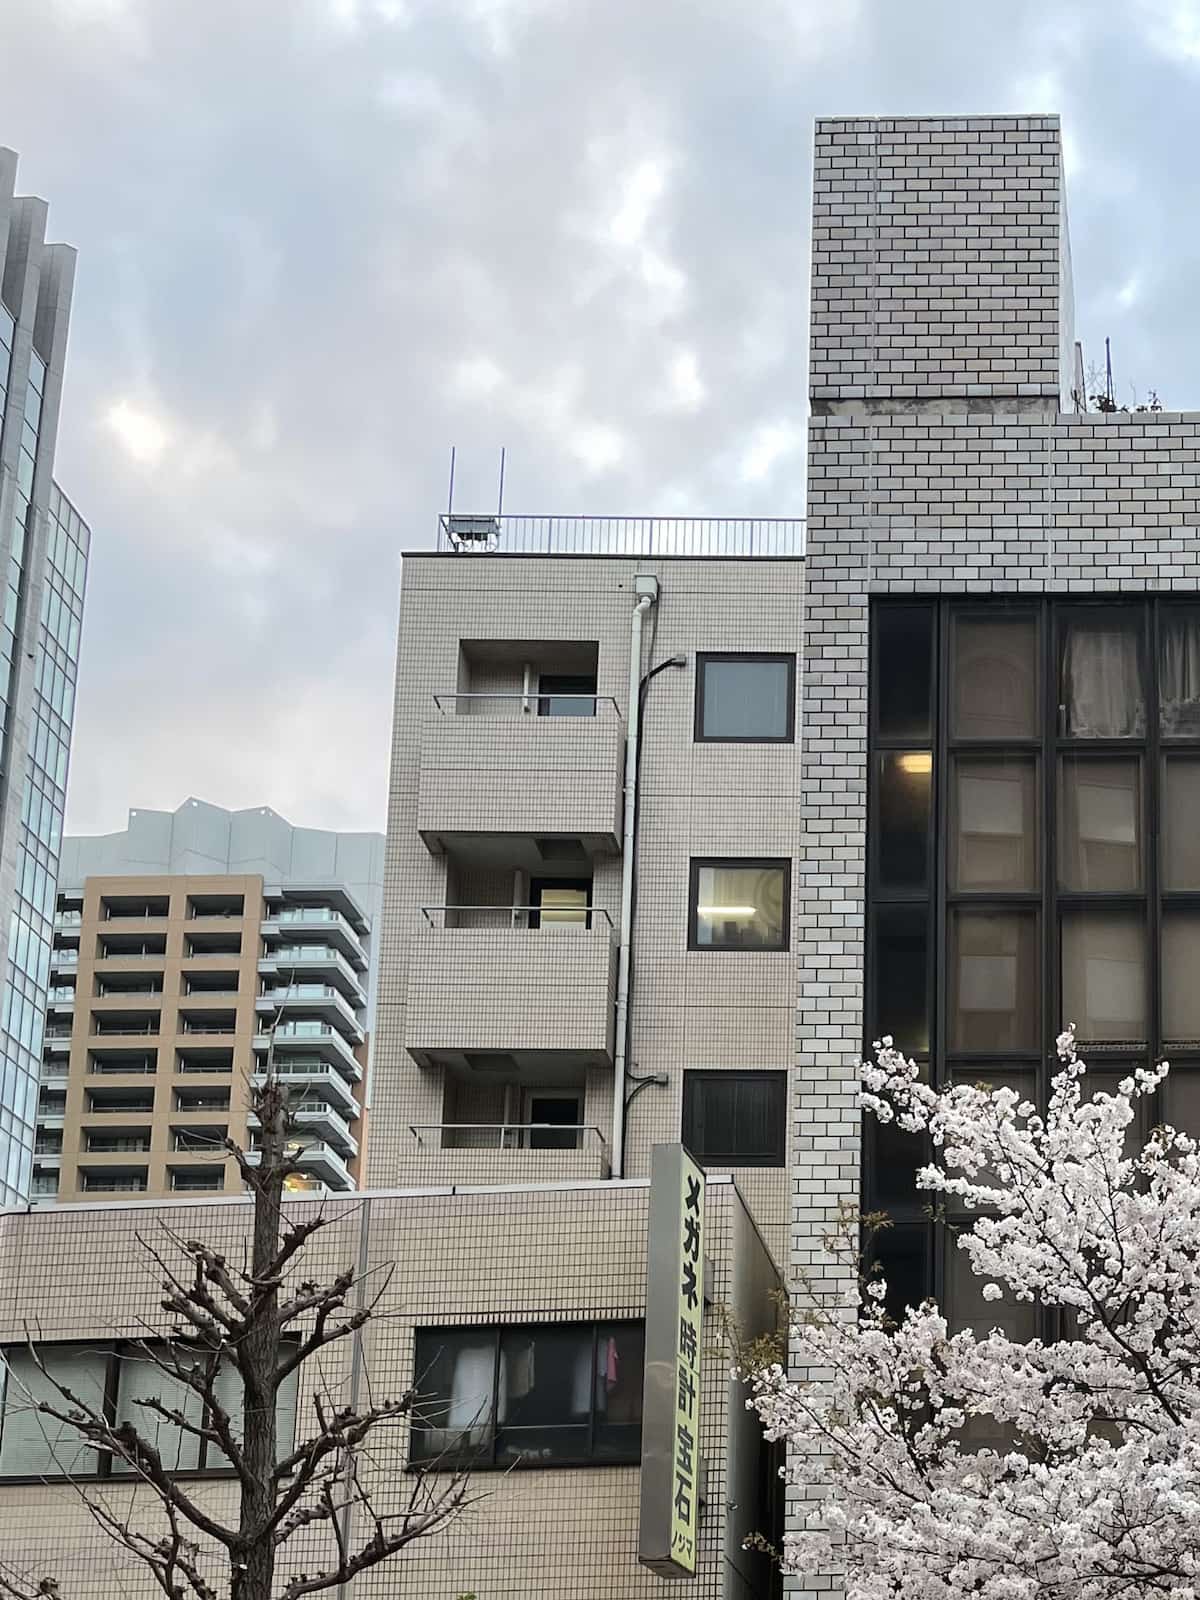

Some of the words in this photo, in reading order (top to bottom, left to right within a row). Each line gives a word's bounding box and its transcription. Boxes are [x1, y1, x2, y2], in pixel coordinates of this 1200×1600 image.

[682, 1175, 701, 1310] メガネ
[679, 1315, 697, 1419] 時計
[675, 1423, 694, 1526] 宝石
